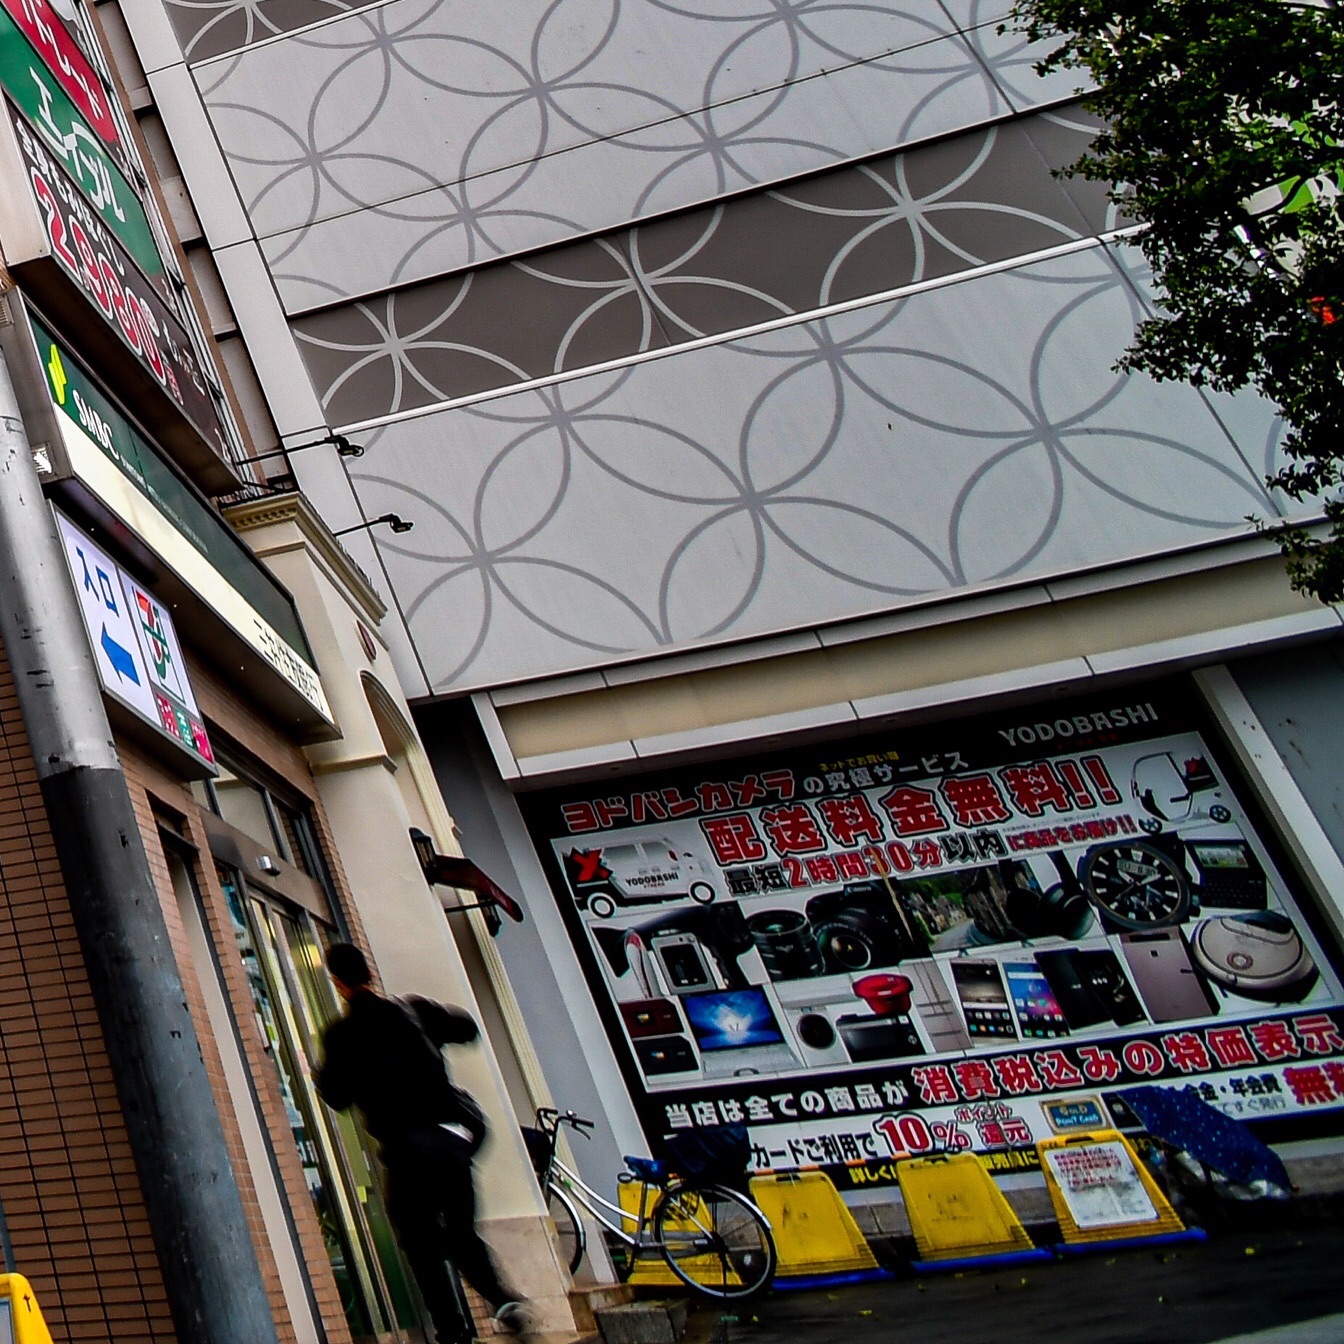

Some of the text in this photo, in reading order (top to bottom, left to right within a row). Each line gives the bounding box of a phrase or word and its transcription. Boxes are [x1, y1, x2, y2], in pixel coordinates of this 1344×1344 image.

[28, 66, 126, 224] エイブル
[15, 117, 126, 278] 全身もみほぐし
[72, 389, 122, 462] SMBC
[75, 545, 120, 619] 入口
[998, 702, 1159, 747] YODOBASHI
[561, 750, 970, 834] ヨドバシカメラ の究極サービス
[698, 753, 1124, 869] 配送料金無料!!
[625, 871, 680, 888] YODOBASHI
[665, 1013, 1344, 1129] 当店は全ての商品が 消費税込みの特価表示
